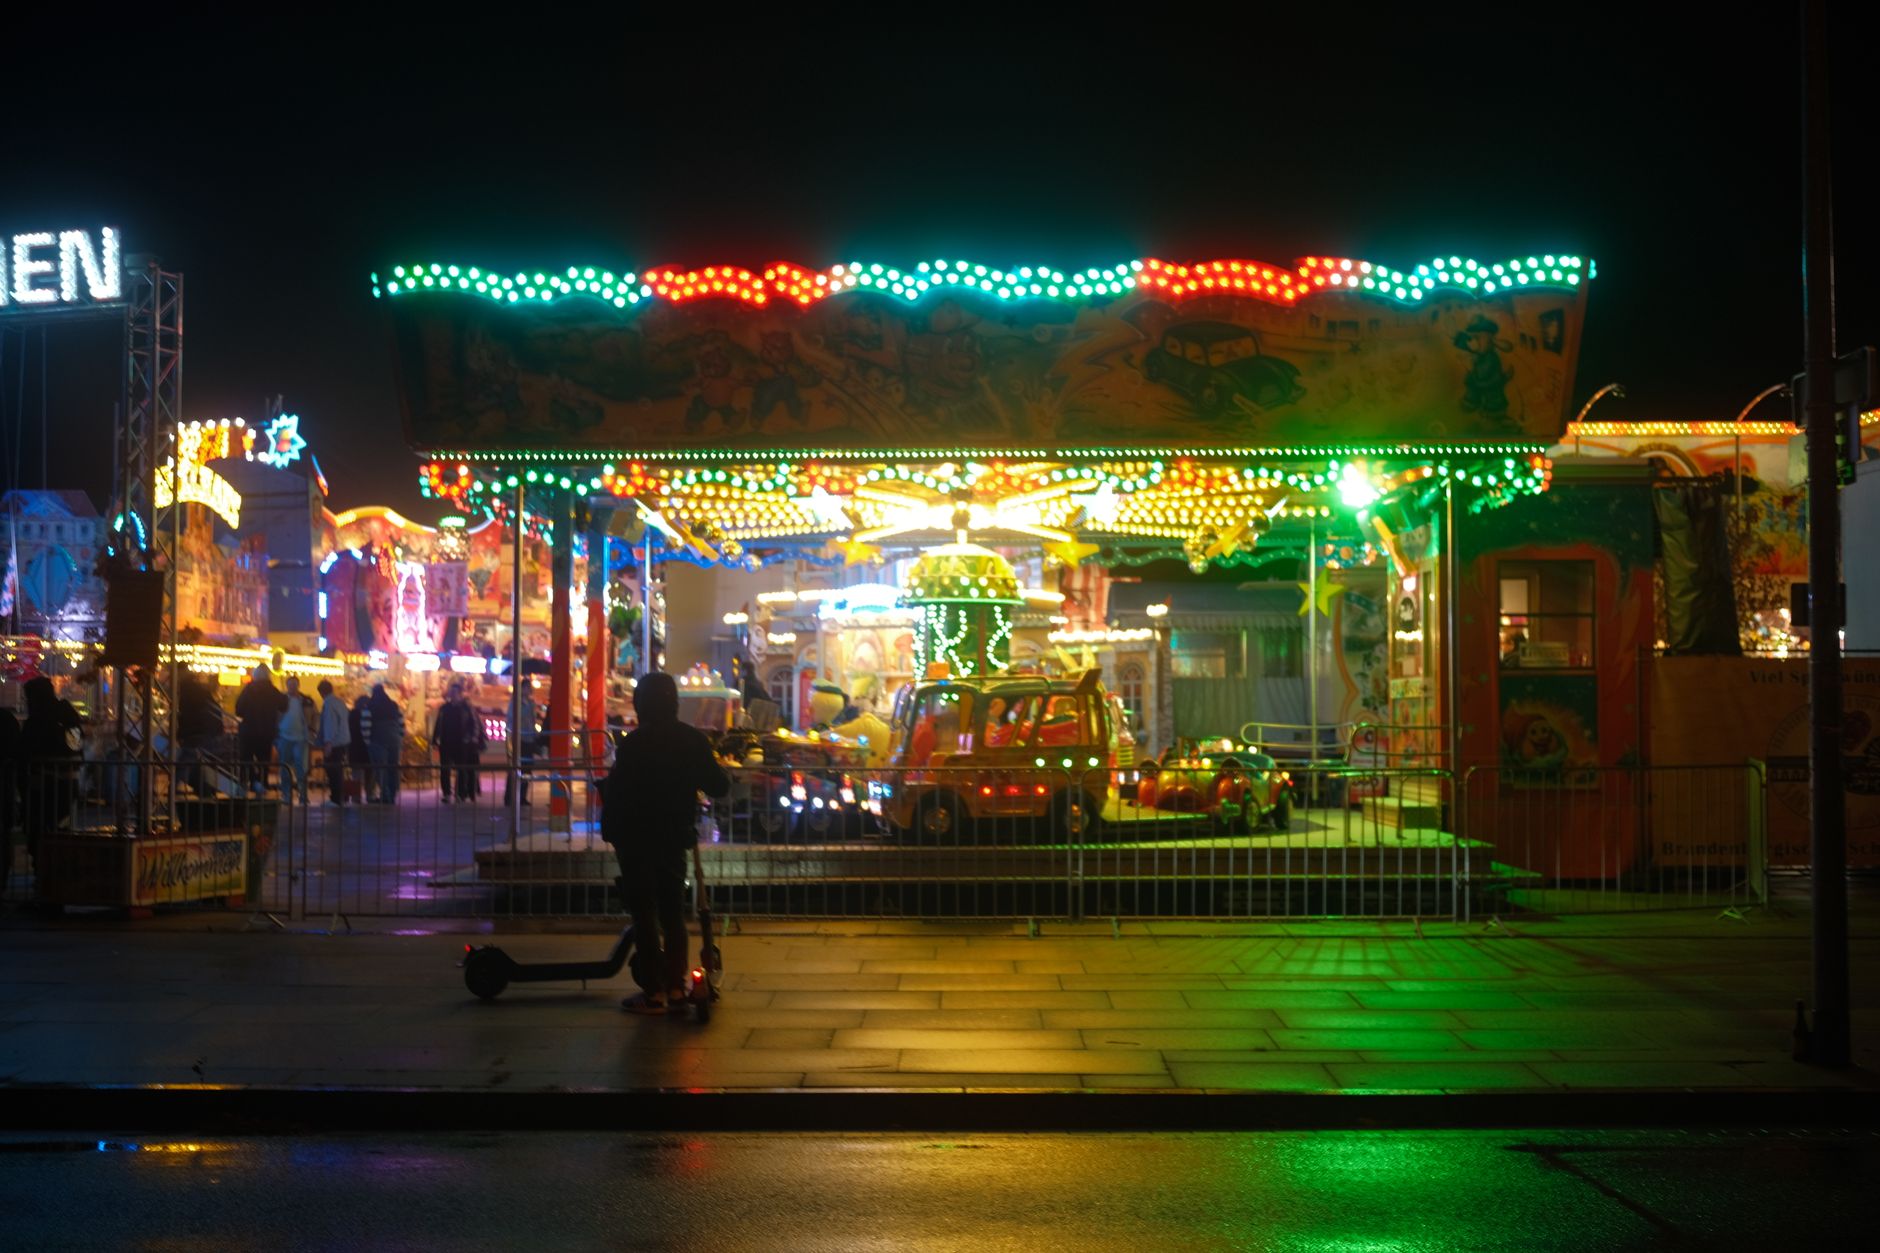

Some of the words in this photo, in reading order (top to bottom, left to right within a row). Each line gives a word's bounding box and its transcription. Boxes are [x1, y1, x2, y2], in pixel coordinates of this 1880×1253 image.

[0, 227, 121, 306] EN
[1750, 669, 1784, 684] Viel
[140, 847, 241, 887] Willkommen
